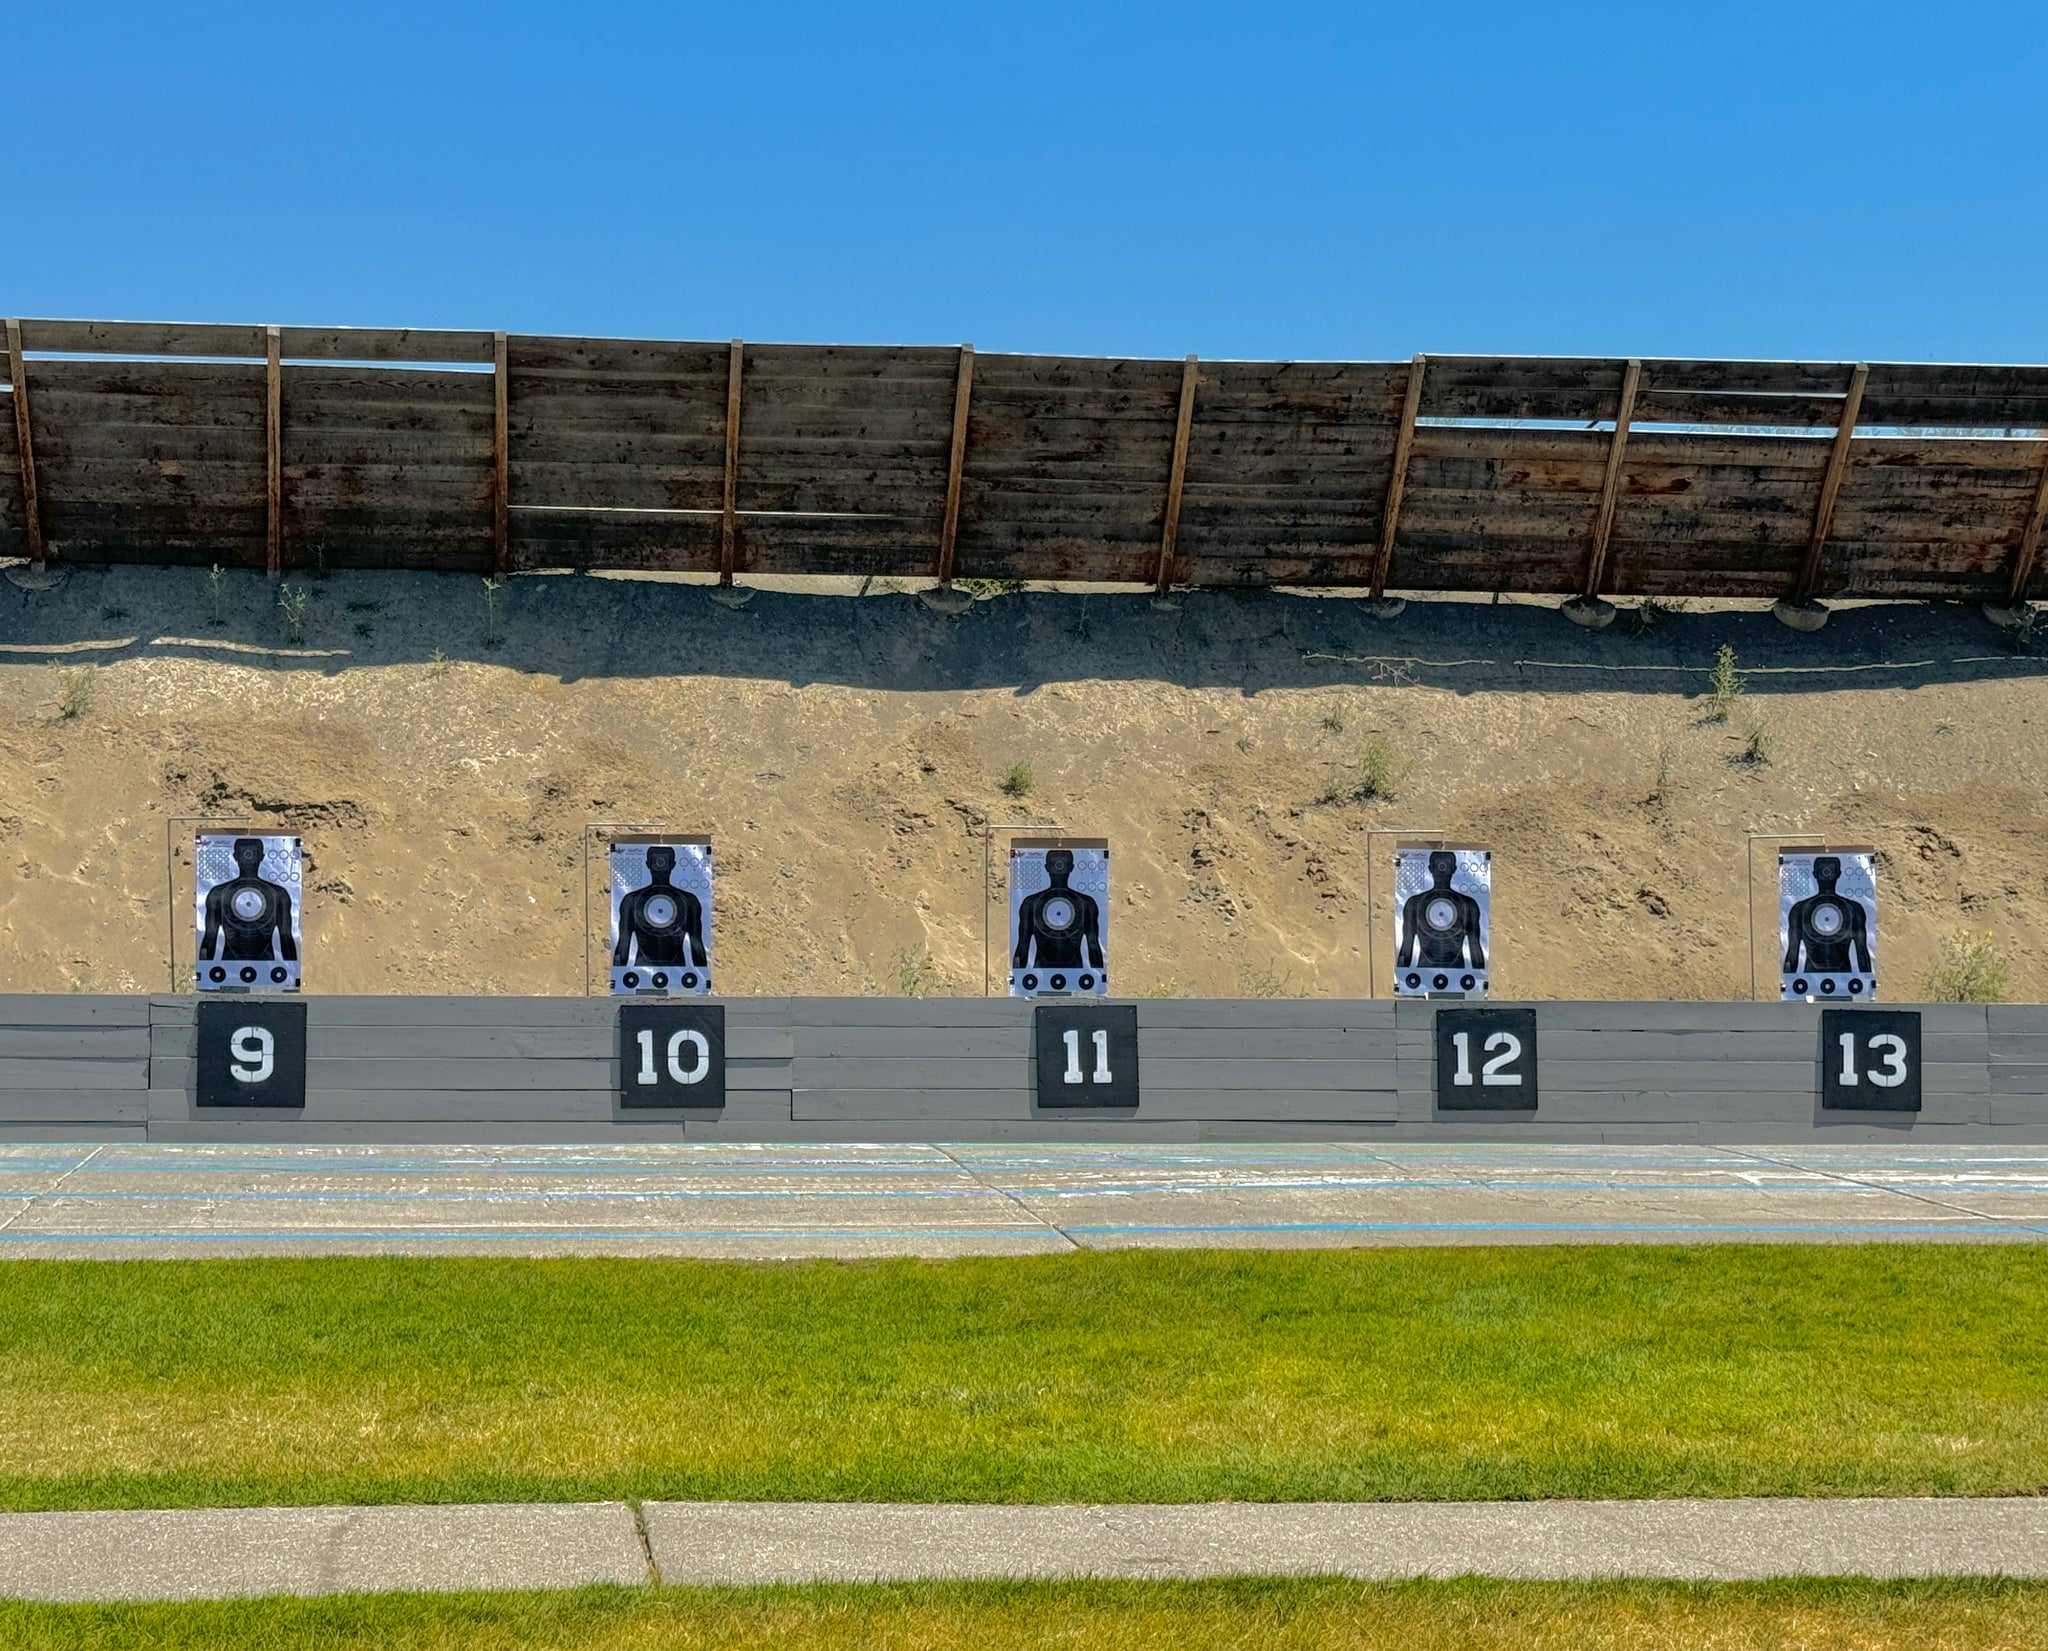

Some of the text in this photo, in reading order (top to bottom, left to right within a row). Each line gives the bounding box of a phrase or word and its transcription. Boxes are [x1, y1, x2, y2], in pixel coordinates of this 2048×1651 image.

[231, 1027, 274, 1083] 9
[638, 1030, 709, 1085] 10
[1063, 1030, 1112, 1084] 11
[1453, 1032, 1522, 1086] 12
[1839, 1033, 1907, 1087] 13
